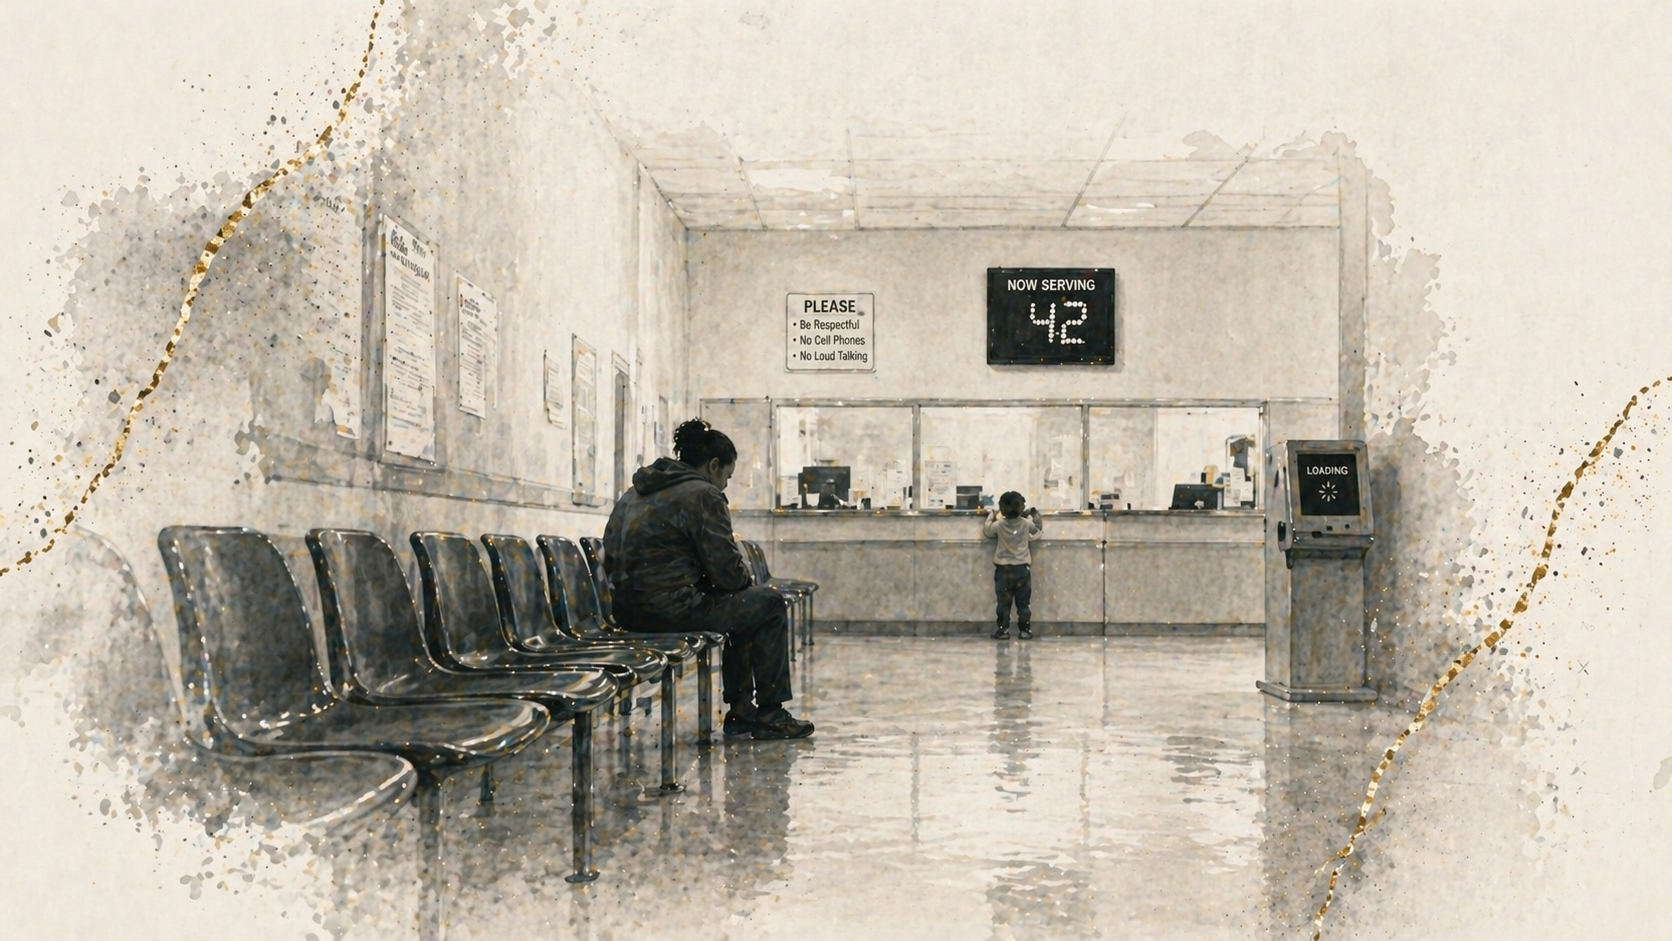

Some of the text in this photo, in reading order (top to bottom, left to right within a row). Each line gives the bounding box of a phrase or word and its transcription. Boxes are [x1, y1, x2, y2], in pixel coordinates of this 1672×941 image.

[1007, 279, 1096, 291] NOW SERVING
[804, 299, 856, 313] PLEASE
[800, 319, 859, 331] Be Respectful
[1029, 301, 1087, 344] 42
[800, 335, 866, 346] No Cell Phones
[800, 351, 868, 363] No Loud Talking
[1307, 466, 1348, 475] LOADING
